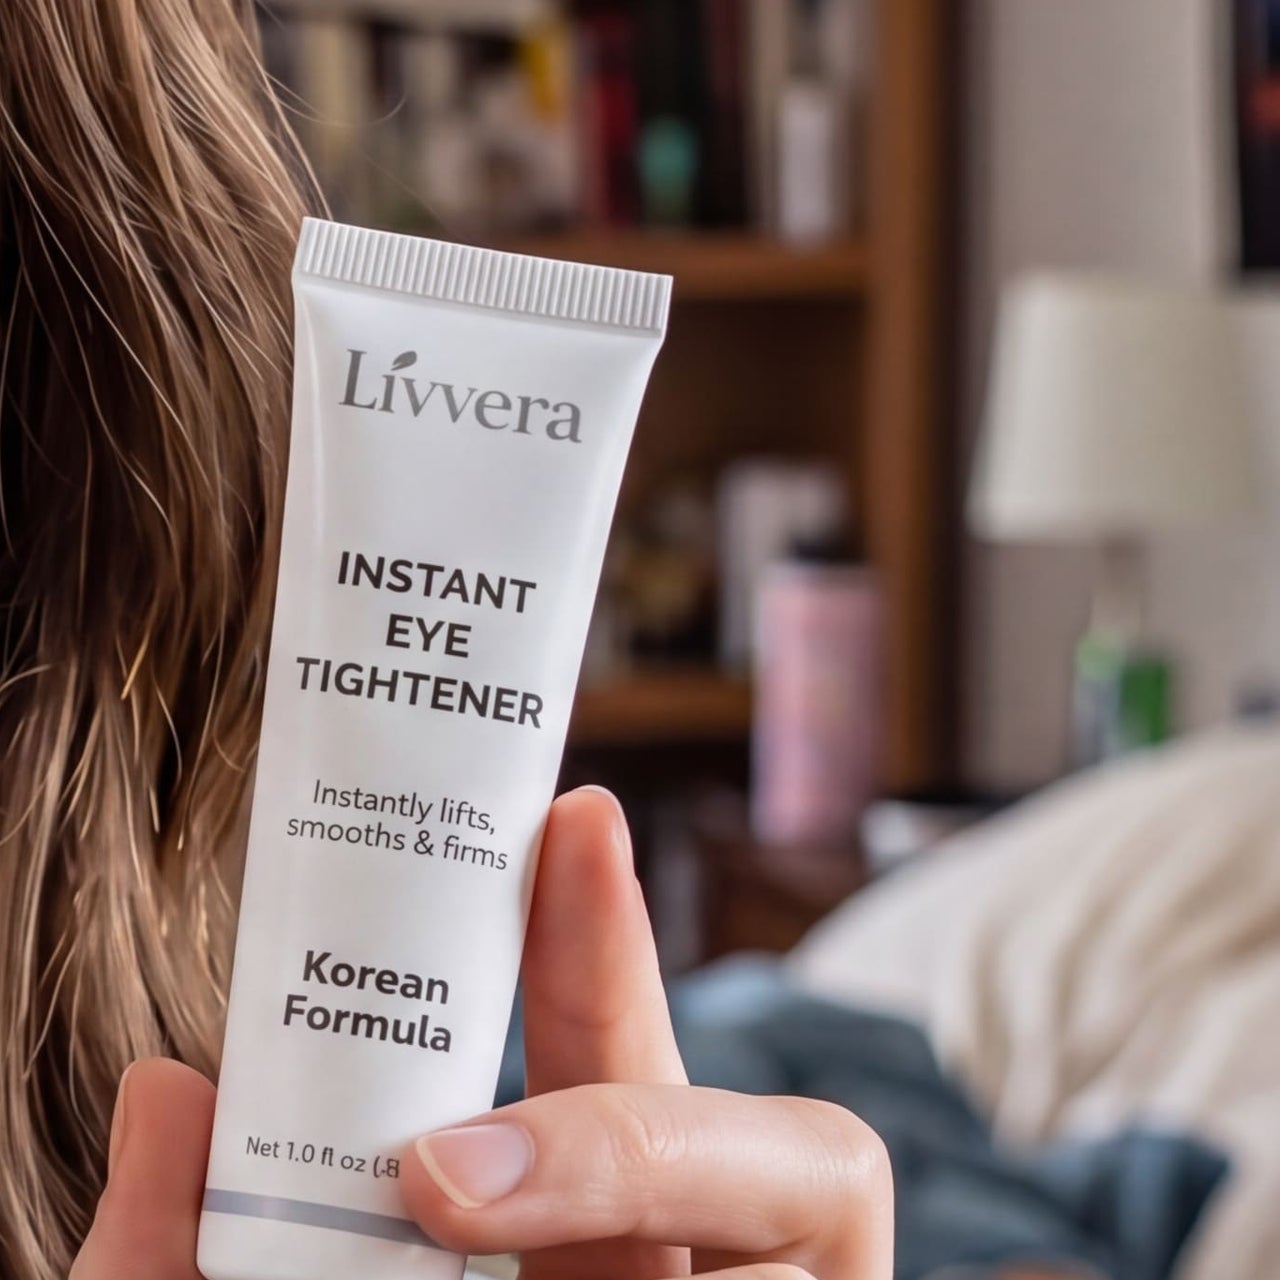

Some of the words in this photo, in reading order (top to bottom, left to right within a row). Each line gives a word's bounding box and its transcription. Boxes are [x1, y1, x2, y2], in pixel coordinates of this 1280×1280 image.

[337, 551, 536, 613] INSTANT
[385, 614, 472, 658] EYE
[296, 657, 544, 728] TIGHTENER
[313, 780, 434, 825] Instantly
[440, 798, 496, 834] lifts,
[287, 818, 406, 852] smooths
[413, 832, 435, 857] &
[443, 836, 508, 870] firms
[302, 950, 450, 1004] Korean
[283, 994, 452, 1053] Formula
[246, 1136, 279, 1158] Net
[286, 1142, 315, 1164] 1.0
[321, 1147, 333, 1167] fl
[340, 1155, 365, 1172] oz
